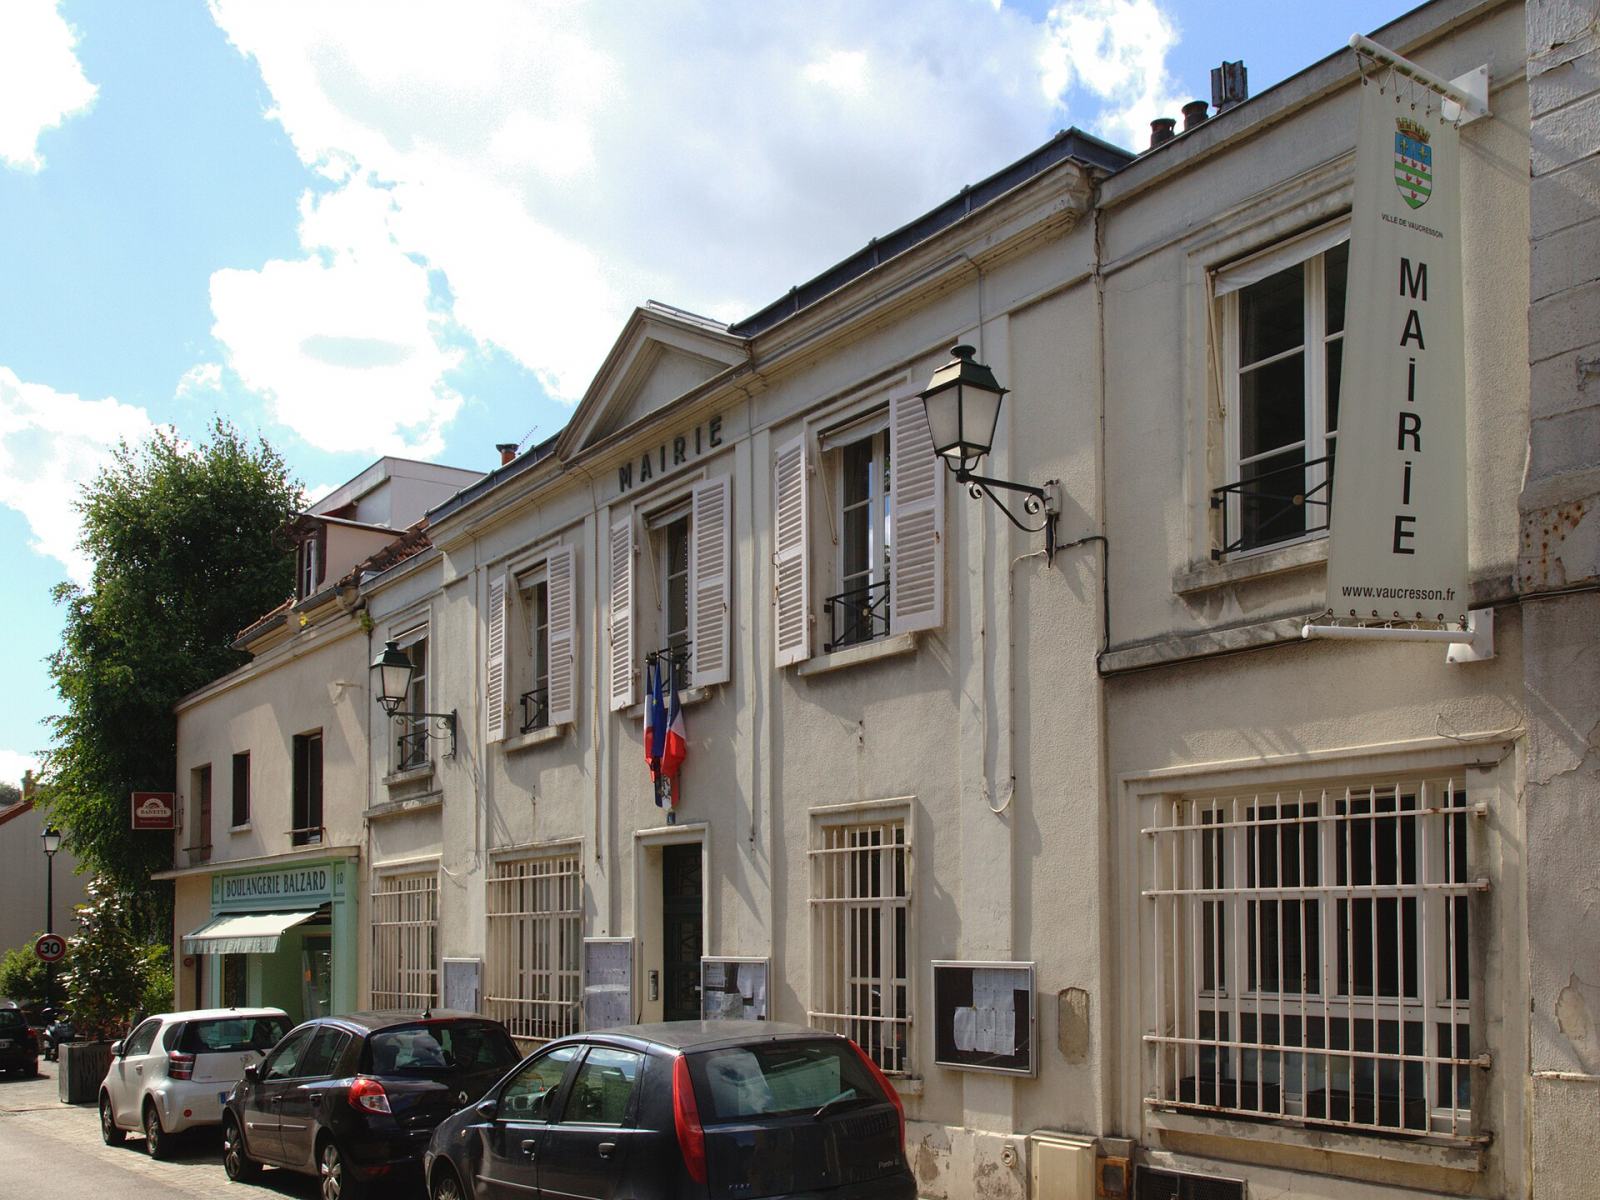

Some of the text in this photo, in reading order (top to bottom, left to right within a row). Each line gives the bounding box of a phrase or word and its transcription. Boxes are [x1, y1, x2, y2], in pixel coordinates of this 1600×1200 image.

[1382, 212, 1443, 239] VILLE DE VAUCRESSON
[618, 415, 722, 493] MAIRIE
[1342, 586, 1455, 601] www.vaucresson.fr
[226, 870, 326, 897] BOULANGERIE BALZARD
[336, 871, 344, 886] 10
[40, 942, 60, 954] 30
